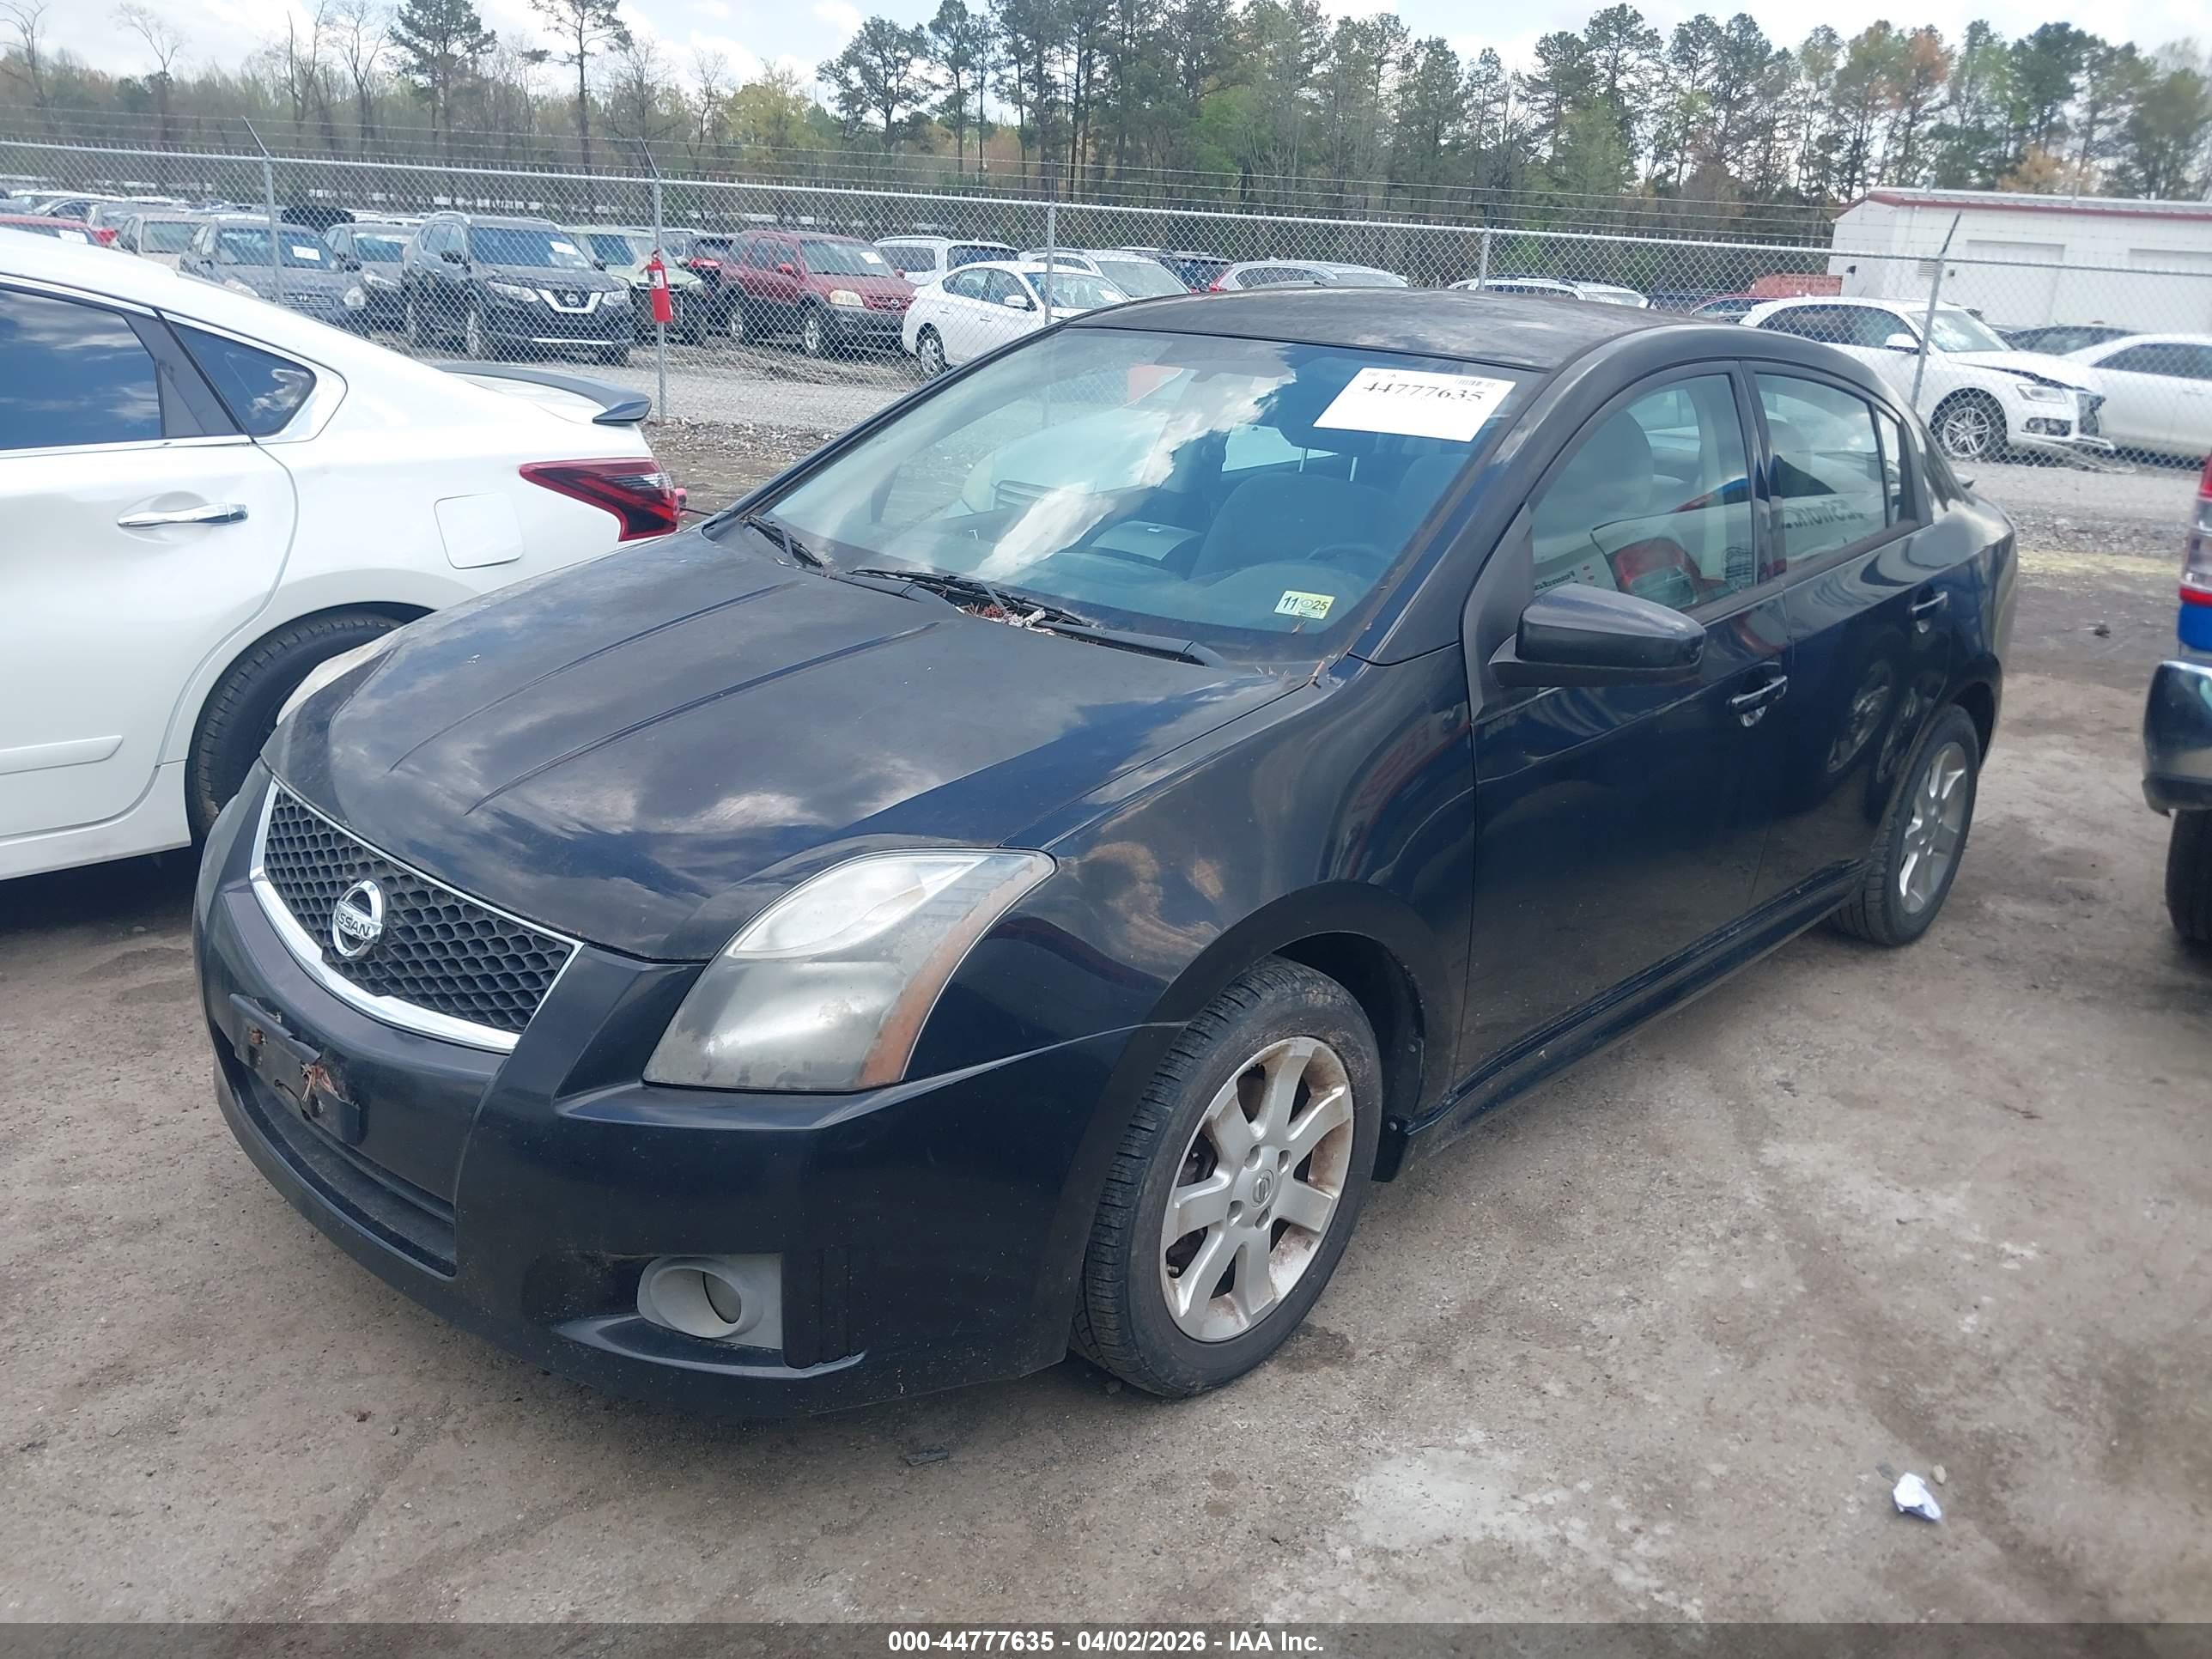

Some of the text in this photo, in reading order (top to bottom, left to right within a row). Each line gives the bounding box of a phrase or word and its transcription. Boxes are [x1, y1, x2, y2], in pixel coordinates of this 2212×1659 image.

[1363, 381, 1486, 402] 44777635
[1283, 596, 1330, 611] 11 25
